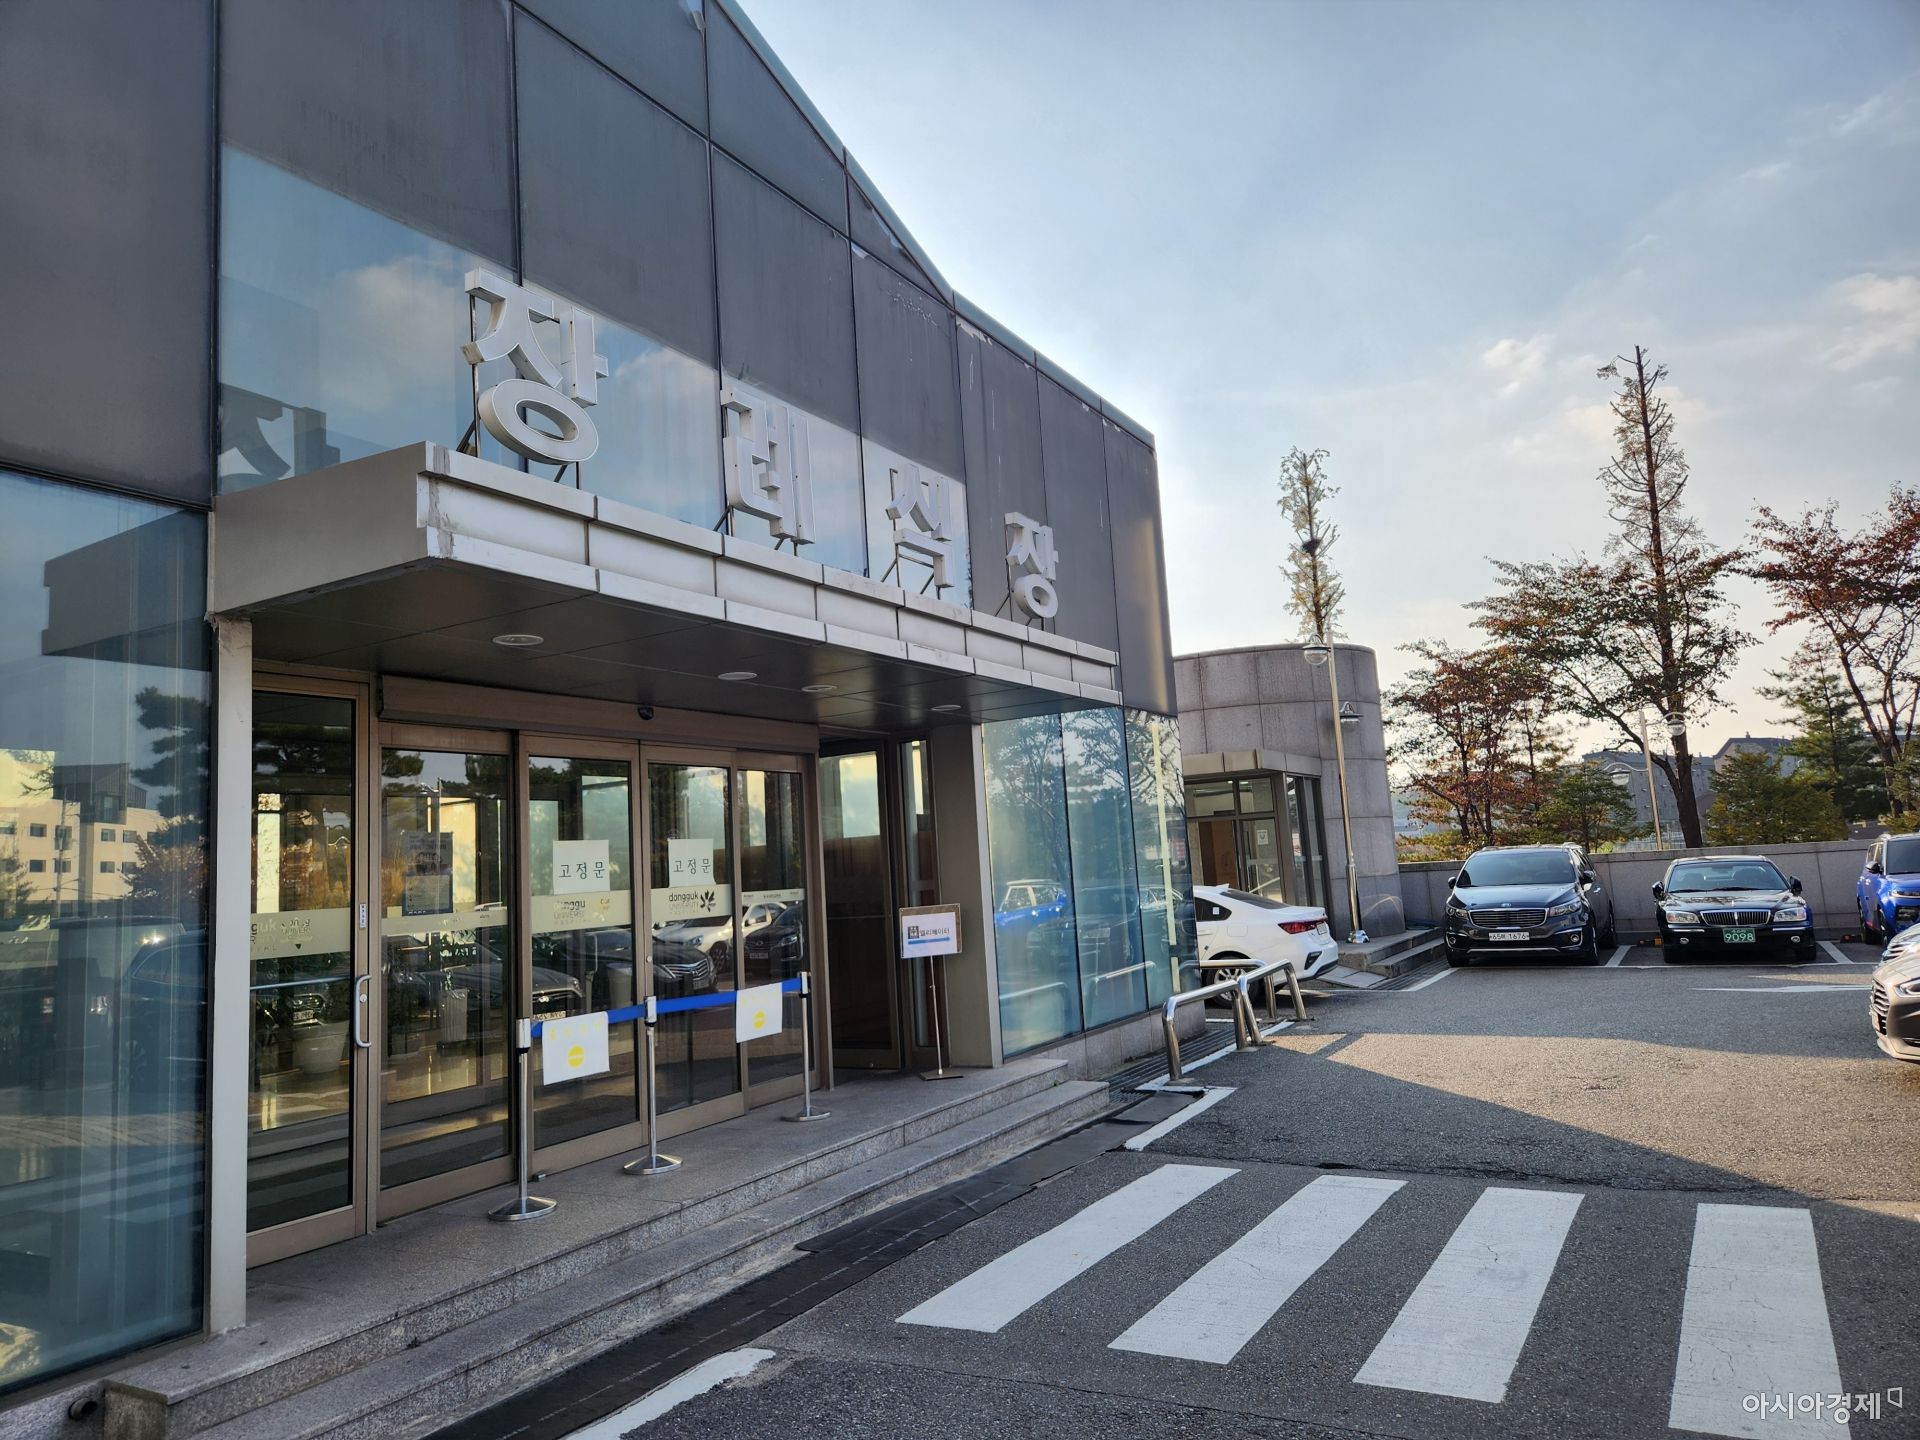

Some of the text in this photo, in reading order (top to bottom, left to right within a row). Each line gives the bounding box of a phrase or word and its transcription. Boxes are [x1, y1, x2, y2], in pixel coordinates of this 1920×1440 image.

[559, 860, 606, 880] 고정문
[672, 857, 711, 875] 고정문
[668, 891, 699, 903] dongguk
[1725, 932, 1754, 942] 9098
